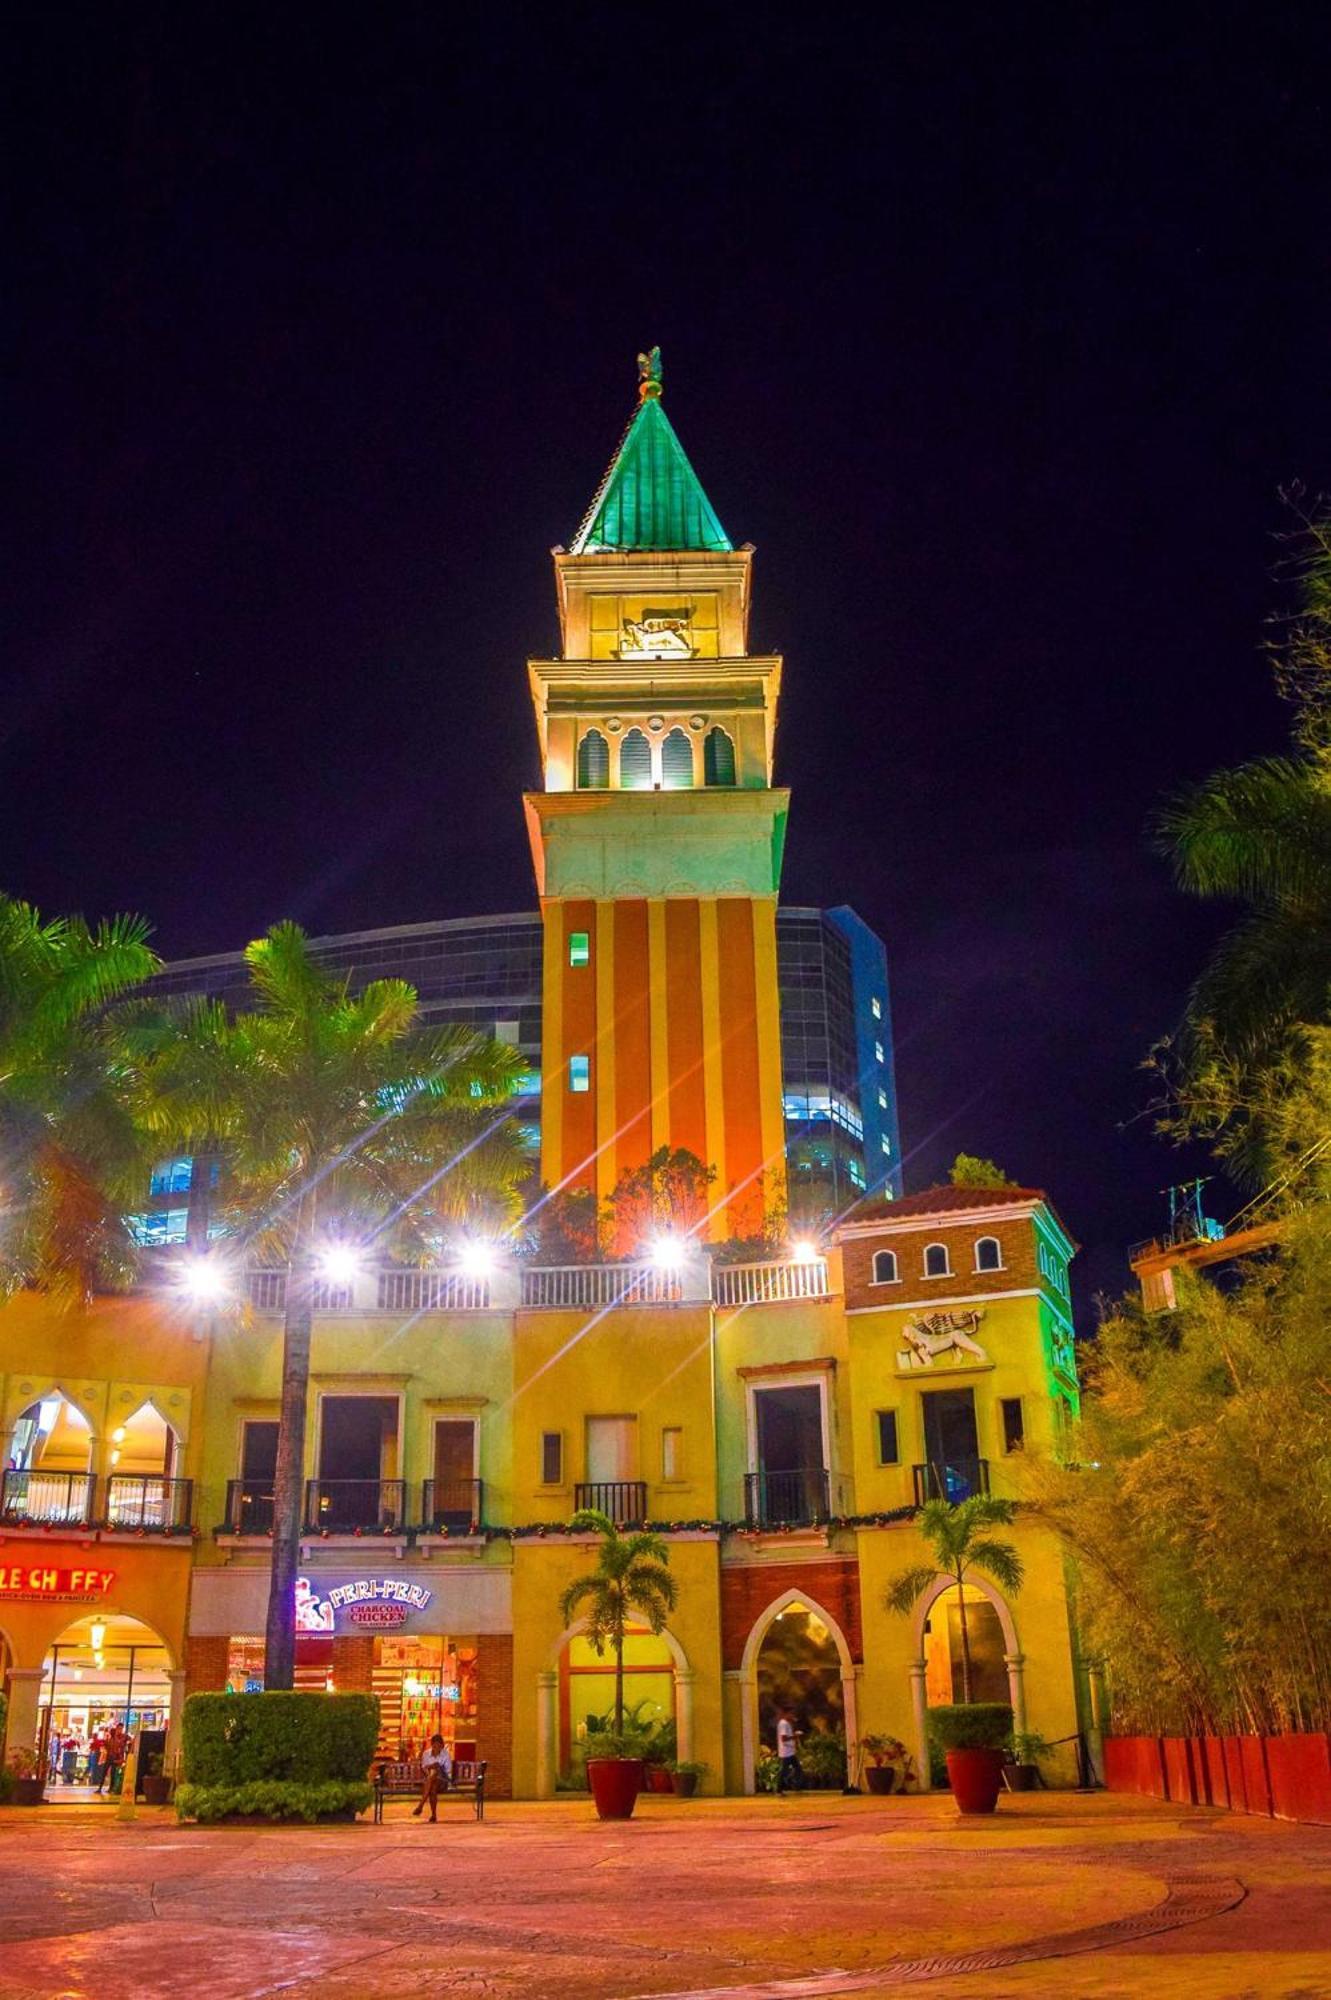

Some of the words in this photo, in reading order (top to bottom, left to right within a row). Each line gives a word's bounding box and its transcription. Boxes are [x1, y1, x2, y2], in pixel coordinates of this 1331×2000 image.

[328, 1579, 432, 1609] PERI-PERI
[350, 1604, 404, 1613] CHARCOAL
[350, 1612, 405, 1621] CHICKEN
